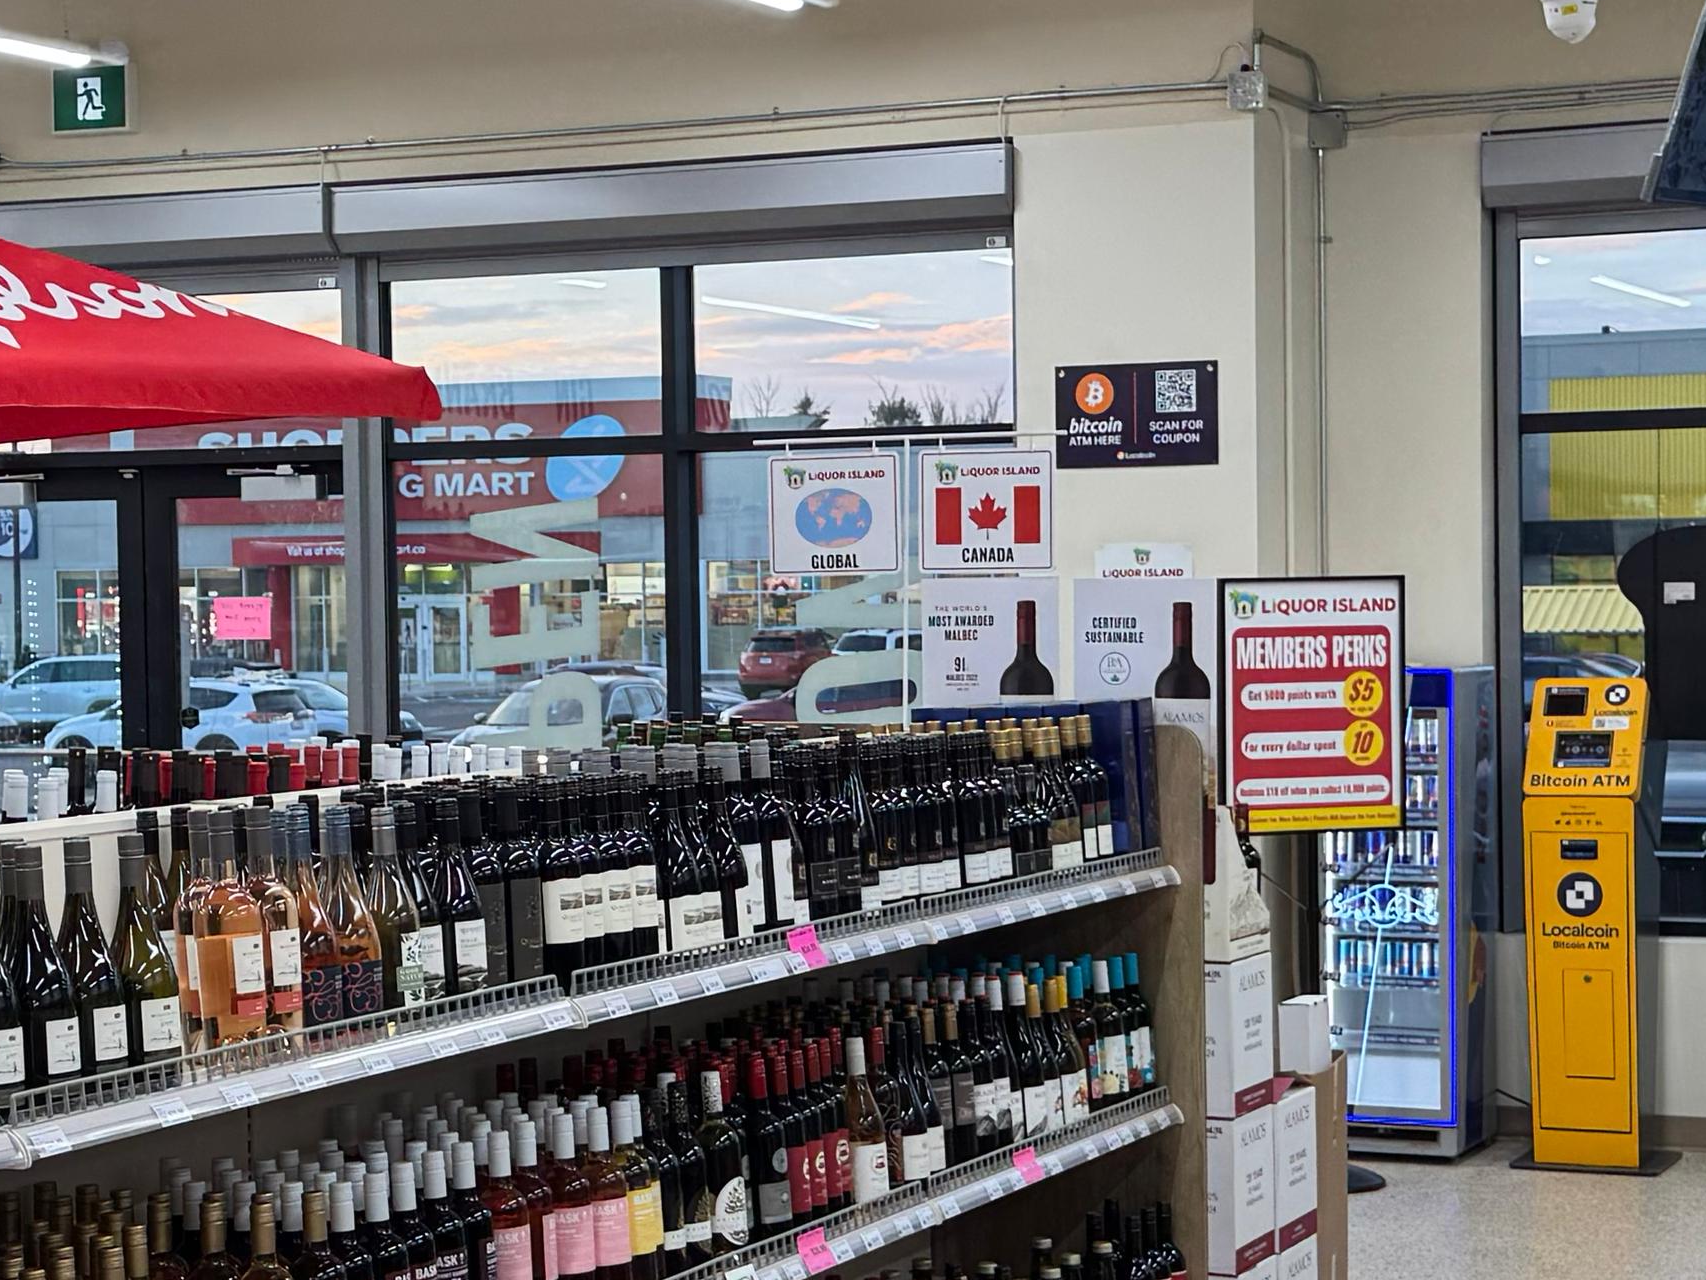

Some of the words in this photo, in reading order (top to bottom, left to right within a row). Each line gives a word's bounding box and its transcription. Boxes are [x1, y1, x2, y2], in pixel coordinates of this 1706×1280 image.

[1070, 416, 1123, 434] bitcoin
[1149, 421, 1179, 431] SCAN
[1182, 420, 1203, 430] FOR
[1069, 436, 1092, 446] ATM
[1094, 435, 1122, 445] HERE
[1153, 433, 1200, 444] COUPON
[847, 469, 885, 480] ISLAND
[1002, 466, 1041, 476] ISLAND
[434, 471, 535, 498] MART
[811, 553, 859, 570] GLOBAL
[962, 547, 1014, 563] CANADA
[1144, 568, 1183, 577] ISLAND
[1333, 598, 1397, 612] ISLAND
[928, 616, 952, 627] MOST
[954, 615, 994, 627] AWARDED
[1092, 617, 1137, 629] CERTIFIED
[944, 629, 978, 641] MALBEC
[1085, 631, 1144, 644] SUSTAINABLE
[1236, 635, 1327, 670] MEMBERS
[1332, 634, 1387, 667] PERKS
[1287, 690, 1312, 703] points
[1349, 678, 1375, 703] $5
[1261, 741, 1284, 754] every
[1286, 740, 1311, 752] dollar
[1353, 731, 1374, 754] 10
[1531, 774, 1587, 787] Bitcoin
[1593, 775, 1630, 787] ATM
[1542, 922, 1620, 937] Localcoin
[1553, 940, 1585, 949] Bitcoin
[1587, 941, 1609, 950] ATM
